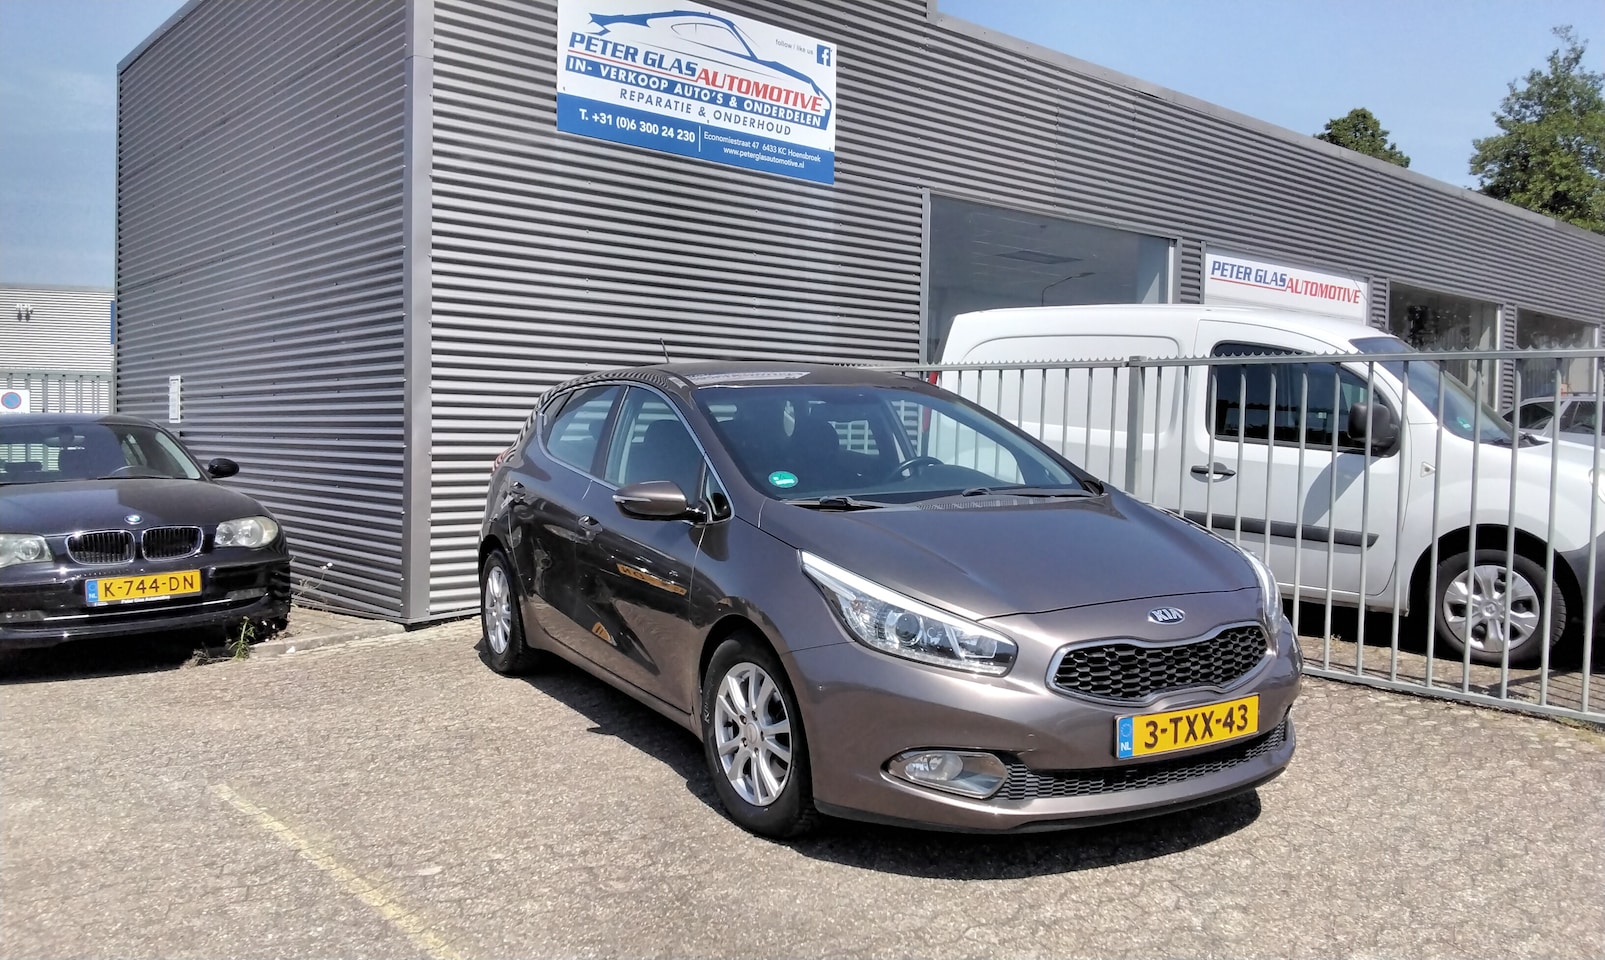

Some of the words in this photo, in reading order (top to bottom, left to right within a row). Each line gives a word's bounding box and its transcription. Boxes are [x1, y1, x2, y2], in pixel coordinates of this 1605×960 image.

[569, 31, 639, 63] PETER
[568, 58, 593, 72] IN-
[600, 65, 669, 91] VERKOOP
[673, 83, 724, 104] AUTO'S
[728, 96, 738, 108] &
[743, 100, 821, 127] ONDERDELEN
[579, 108, 589, 121] T.
[591, 112, 613, 125] +31
[616, 116, 637, 131] (0)6
[639, 121, 659, 135] 300
[661, 126, 674, 138] 24
[676, 130, 696, 143] 230
[619, 88, 692, 114] REPARATIE
[698, 106, 706, 118] &
[713, 110, 791, 135] ONDERHOUD
[703, 131, 751, 149] Economiestraat
[751, 141, 760, 150] 47
[762, 143, 777, 153] 6433
[777, 147, 787, 156] KC
[787, 151, 821, 163] Hoensbroek
[723, 147, 805, 169] www.peterglasautomotive.nl
[1211, 260, 1252, 282] PETER
[103, 575, 194, 598] K-744-DN
[1151, 609, 1183, 622] KIA
[1144, 704, 1249, 748] 3-TXX-43
[1120, 741, 1132, 751] NL
